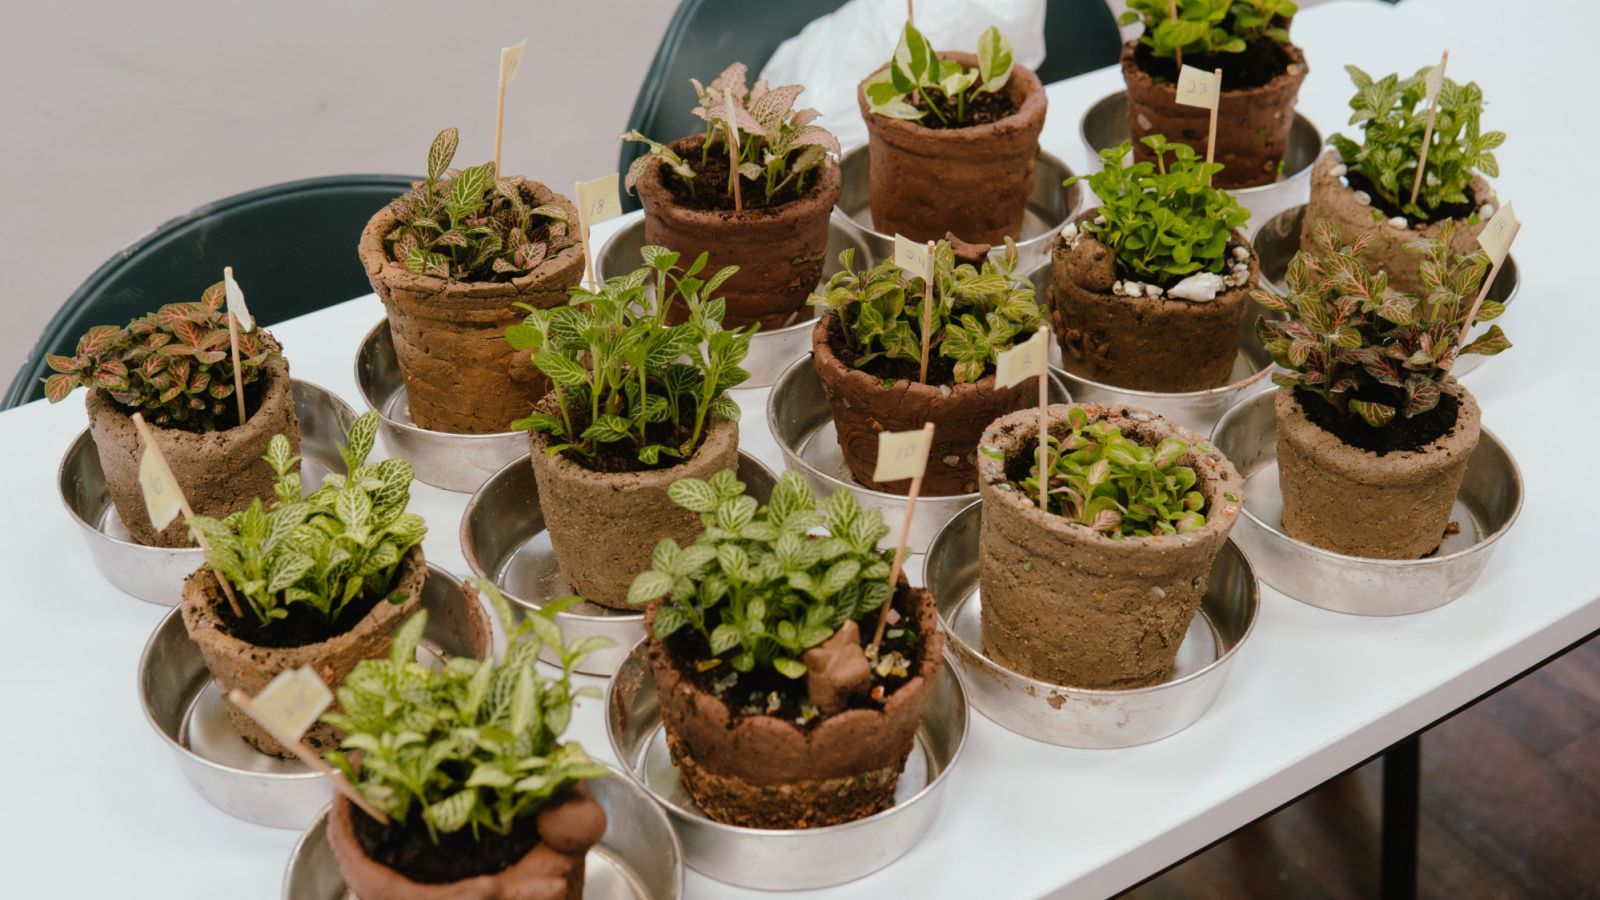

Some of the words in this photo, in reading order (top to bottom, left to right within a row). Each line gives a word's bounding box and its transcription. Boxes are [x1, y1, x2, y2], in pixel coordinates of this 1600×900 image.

[1186, 80, 1208, 95] 23
[590, 198, 605, 217] 18
[905, 249, 926, 271] 24
[895, 443, 917, 461] 10
